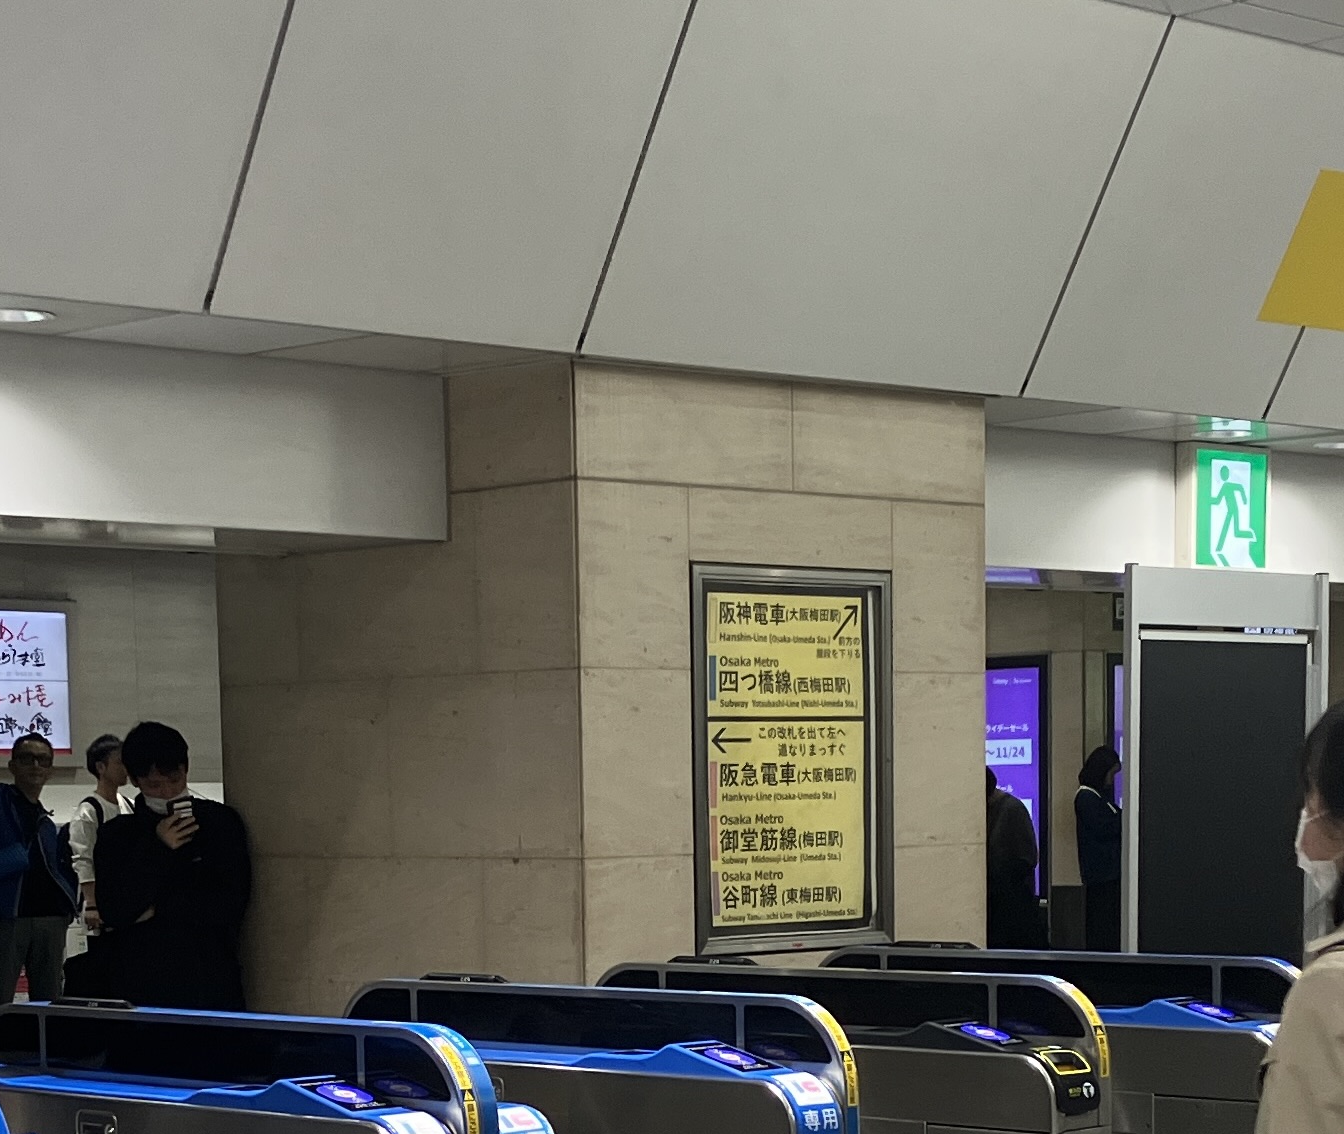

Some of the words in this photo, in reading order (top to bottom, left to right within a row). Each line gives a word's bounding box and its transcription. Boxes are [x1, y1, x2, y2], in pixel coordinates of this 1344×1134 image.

[719, 655, 752, 668] Osaka
[753, 655, 780, 668] Metro
[719, 698, 749, 709] Subway
[758, 726, 847, 740] この改札を出て左へ
[777, 743, 847, 757] 道なりまっすぐ
[721, 791, 773, 803] Hankyu-Line
[719, 813, 752, 826] Osaka
[754, 813, 785, 825] Metro
[721, 855, 749, 866] Subway
[721, 870, 752, 882] Osaka
[754, 869, 784, 881] Metro
[802, 1107, 839, 1132] 専用
